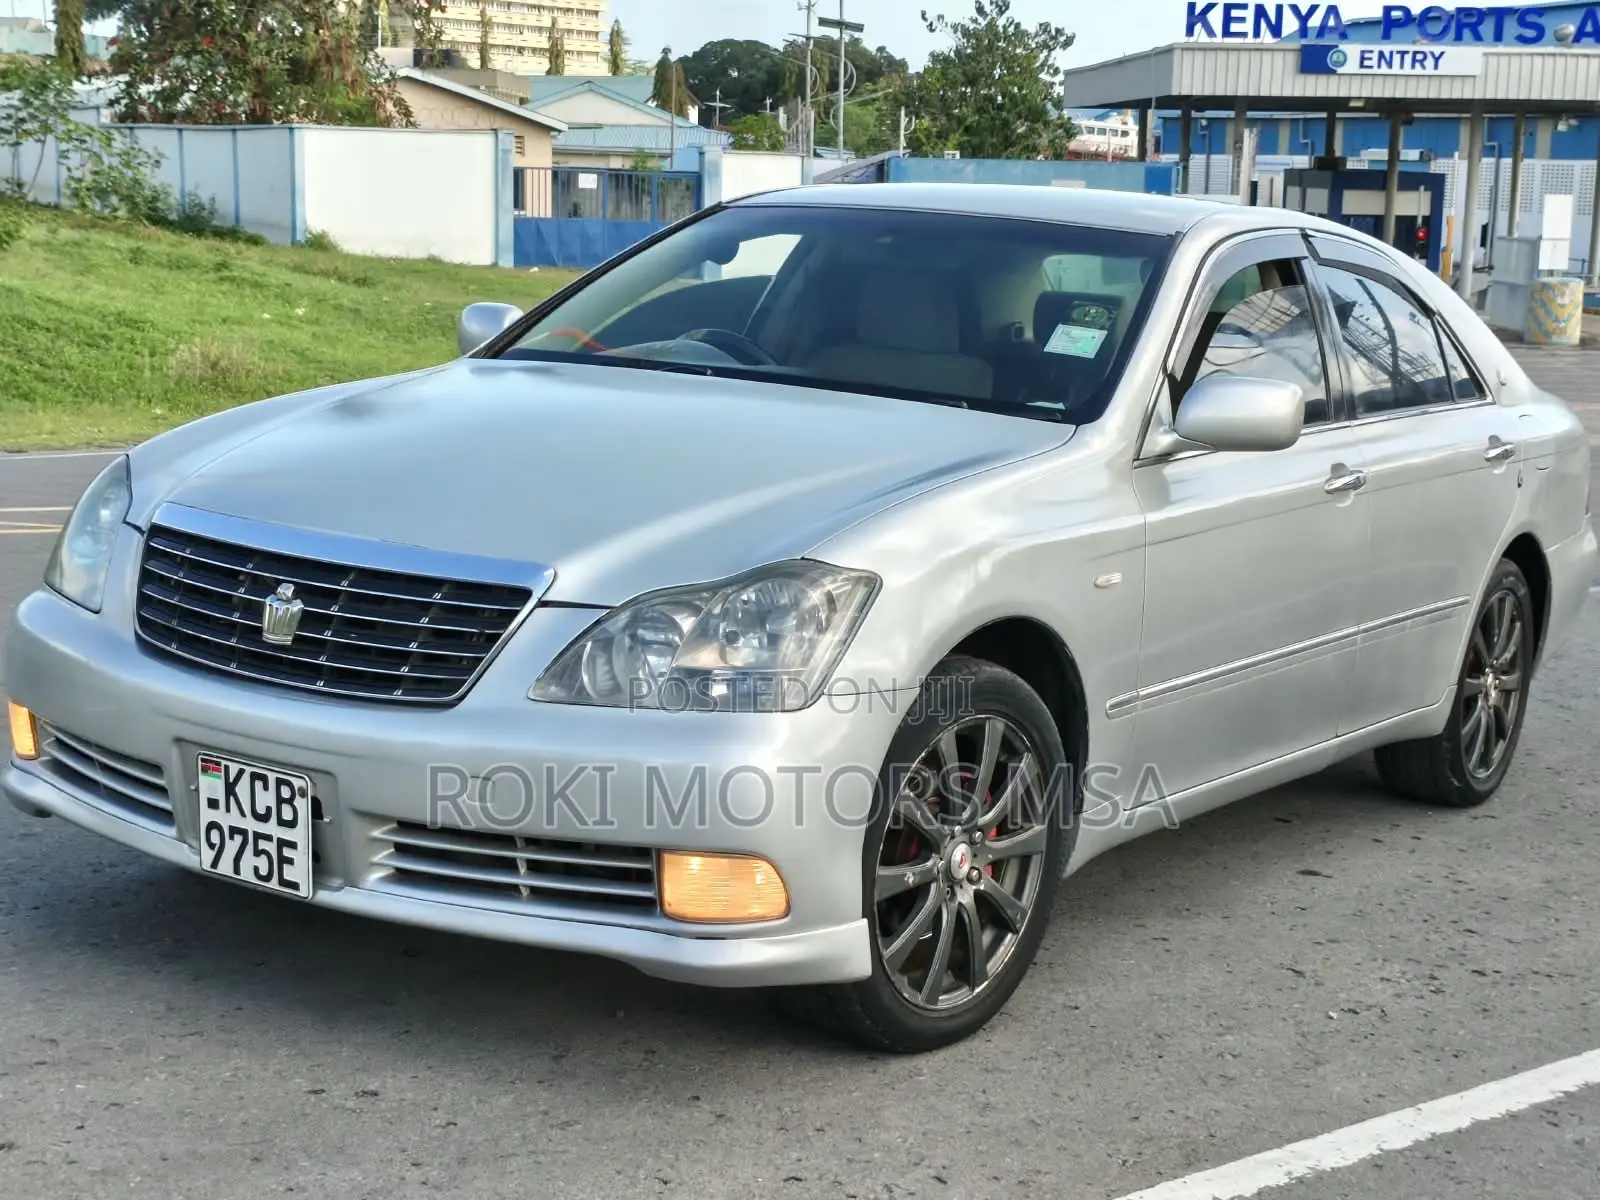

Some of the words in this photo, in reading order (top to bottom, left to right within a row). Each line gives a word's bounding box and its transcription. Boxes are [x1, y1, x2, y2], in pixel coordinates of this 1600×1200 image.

[1185, 2, 1348, 40] KENYA
[1381, 5, 1546, 44] PORTS
[1359, 50, 1445, 70] ENTRY
[224, 764, 298, 829] KCB
[205, 820, 300, 891] 975E
